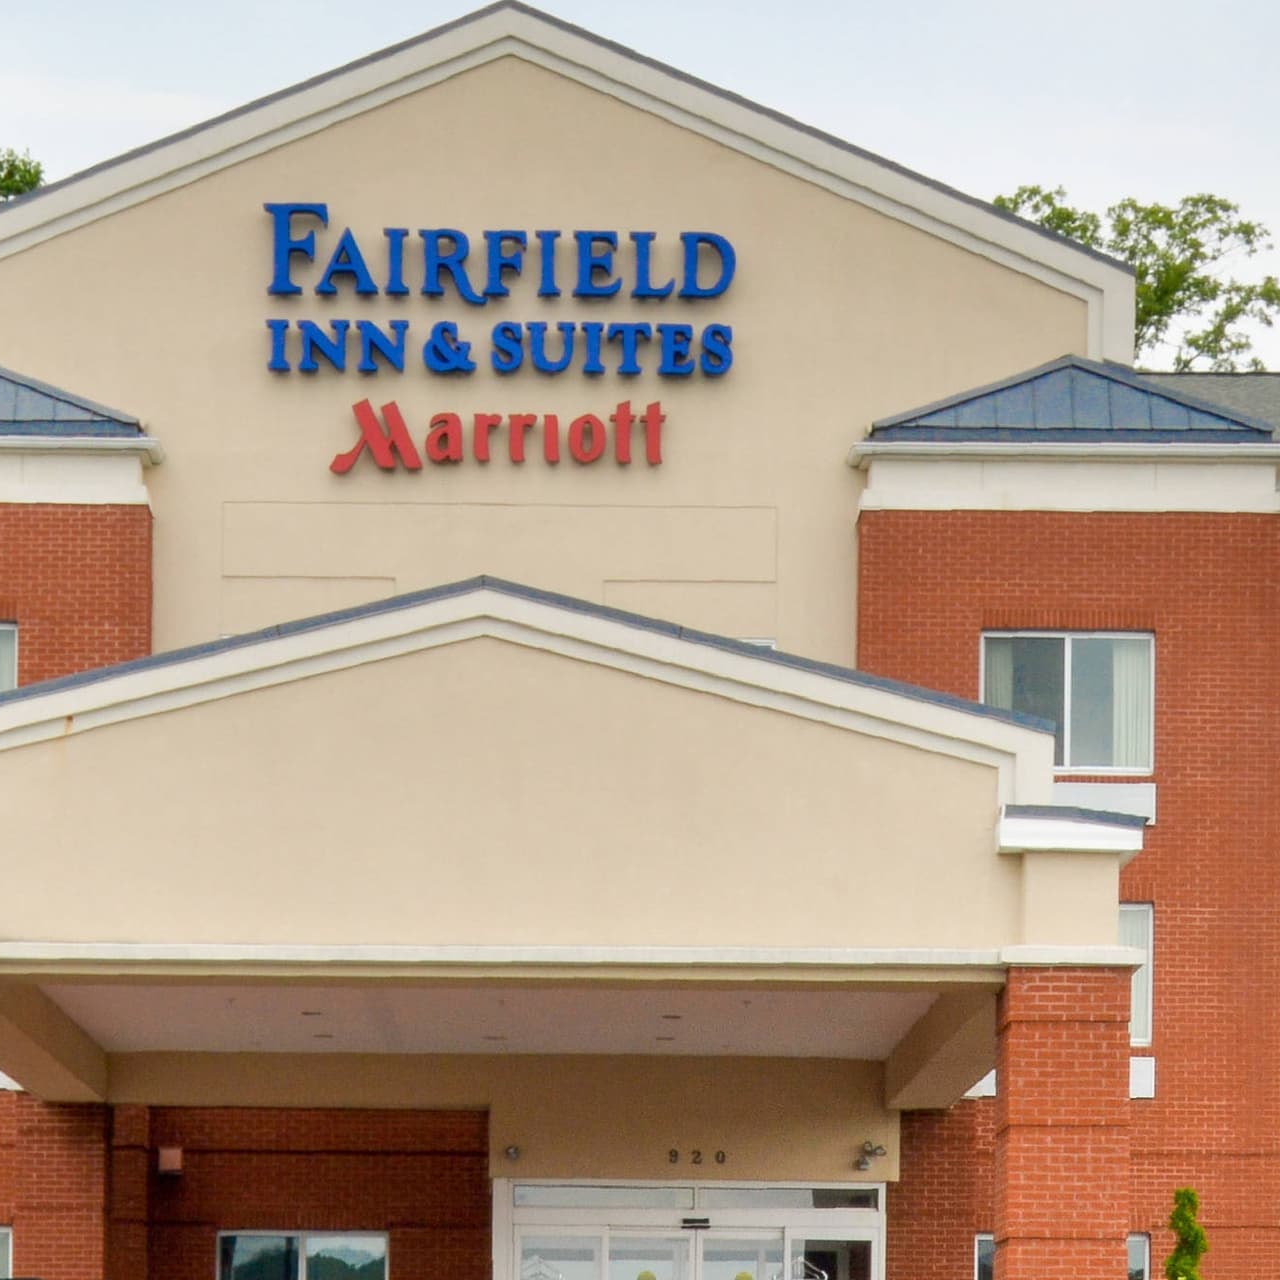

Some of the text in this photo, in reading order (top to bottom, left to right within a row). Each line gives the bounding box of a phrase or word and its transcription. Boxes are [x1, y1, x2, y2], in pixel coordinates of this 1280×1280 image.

[264, 202, 737, 305] FAIRFIELD
[266, 319, 734, 376] INN & SUITES
[329, 398, 667, 473] Marriott
